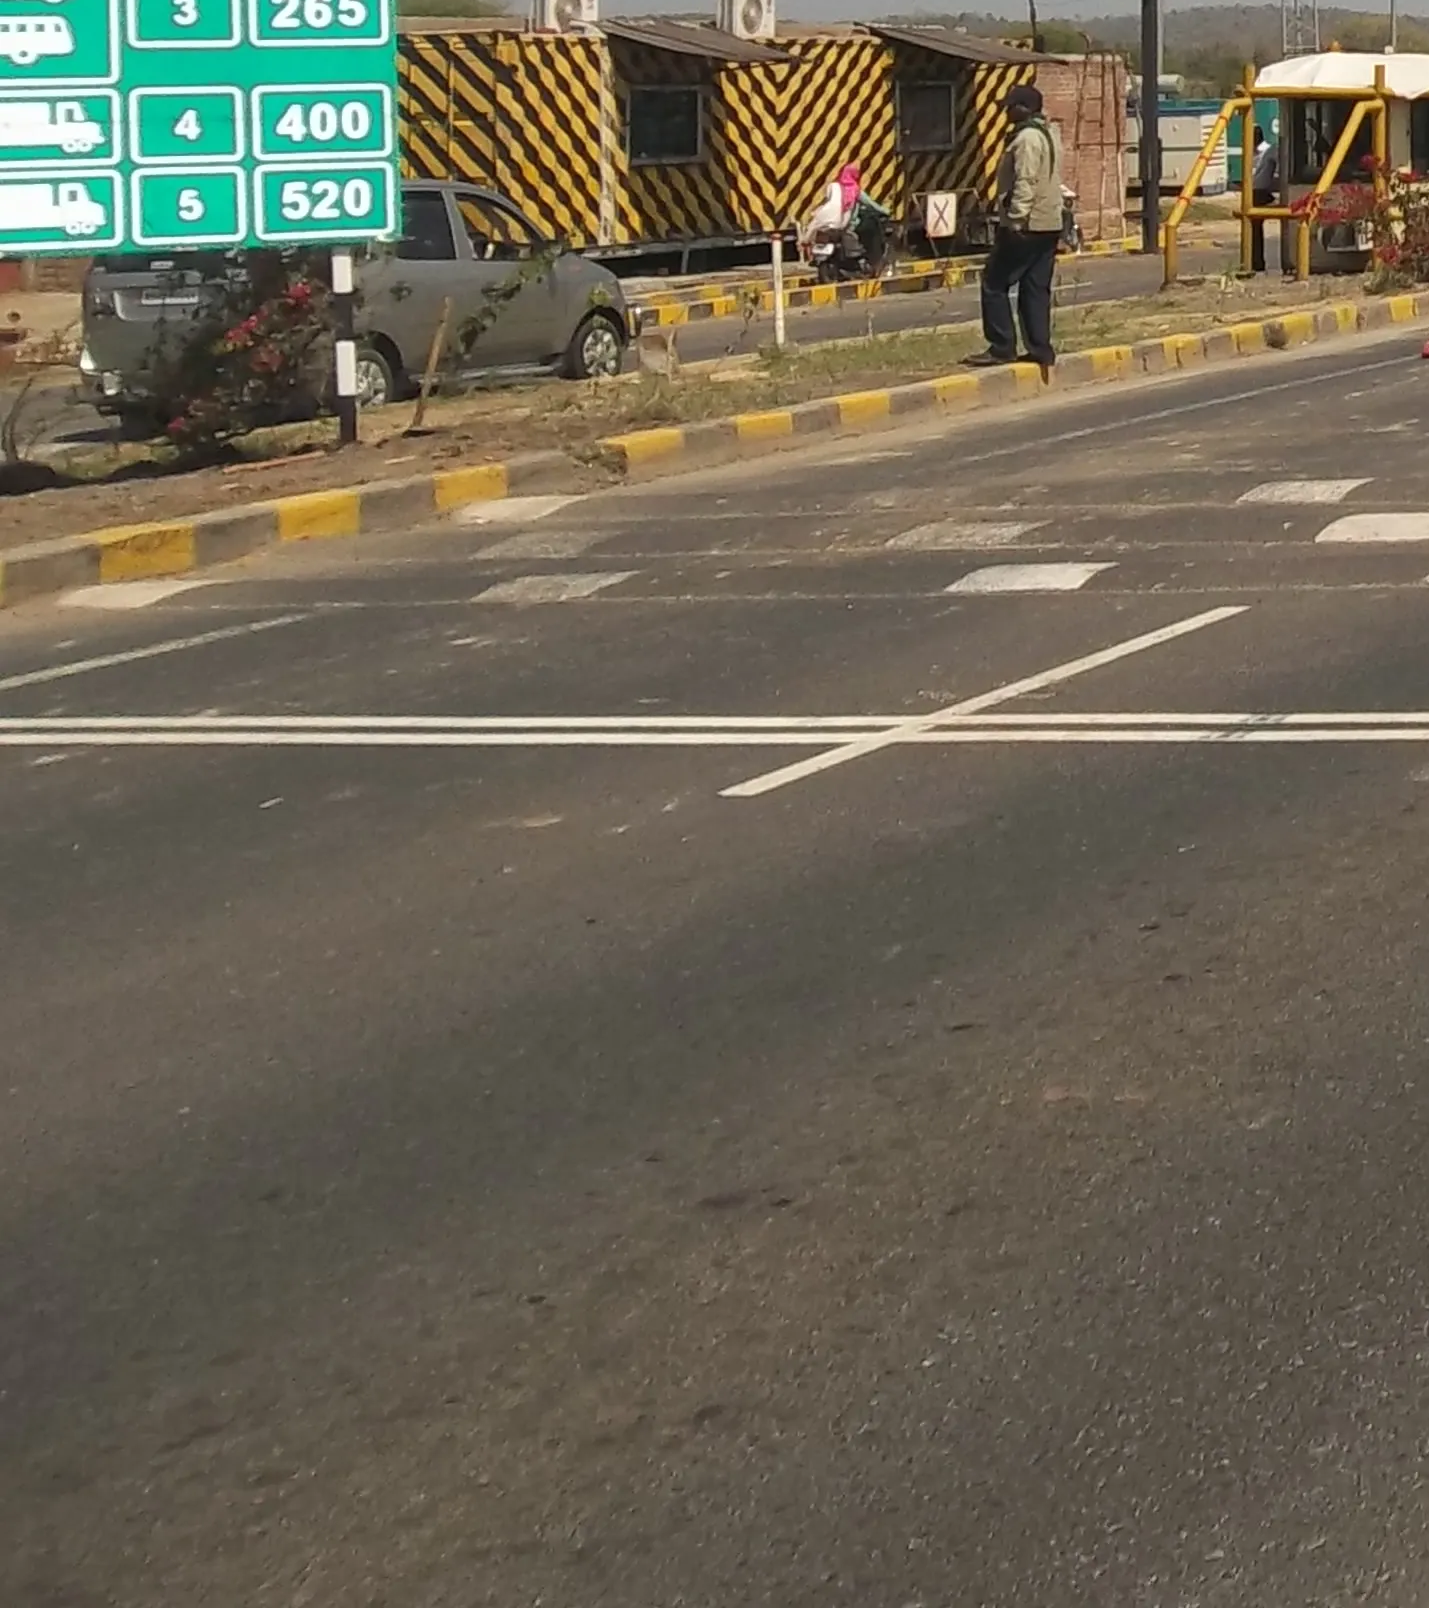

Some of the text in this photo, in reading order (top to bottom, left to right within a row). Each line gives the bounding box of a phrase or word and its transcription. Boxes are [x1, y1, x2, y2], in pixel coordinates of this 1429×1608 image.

[173, 109, 202, 141] 4
[275, 101, 371, 142] 400
[178, 189, 205, 221] 5
[281, 178, 373, 221] 520
